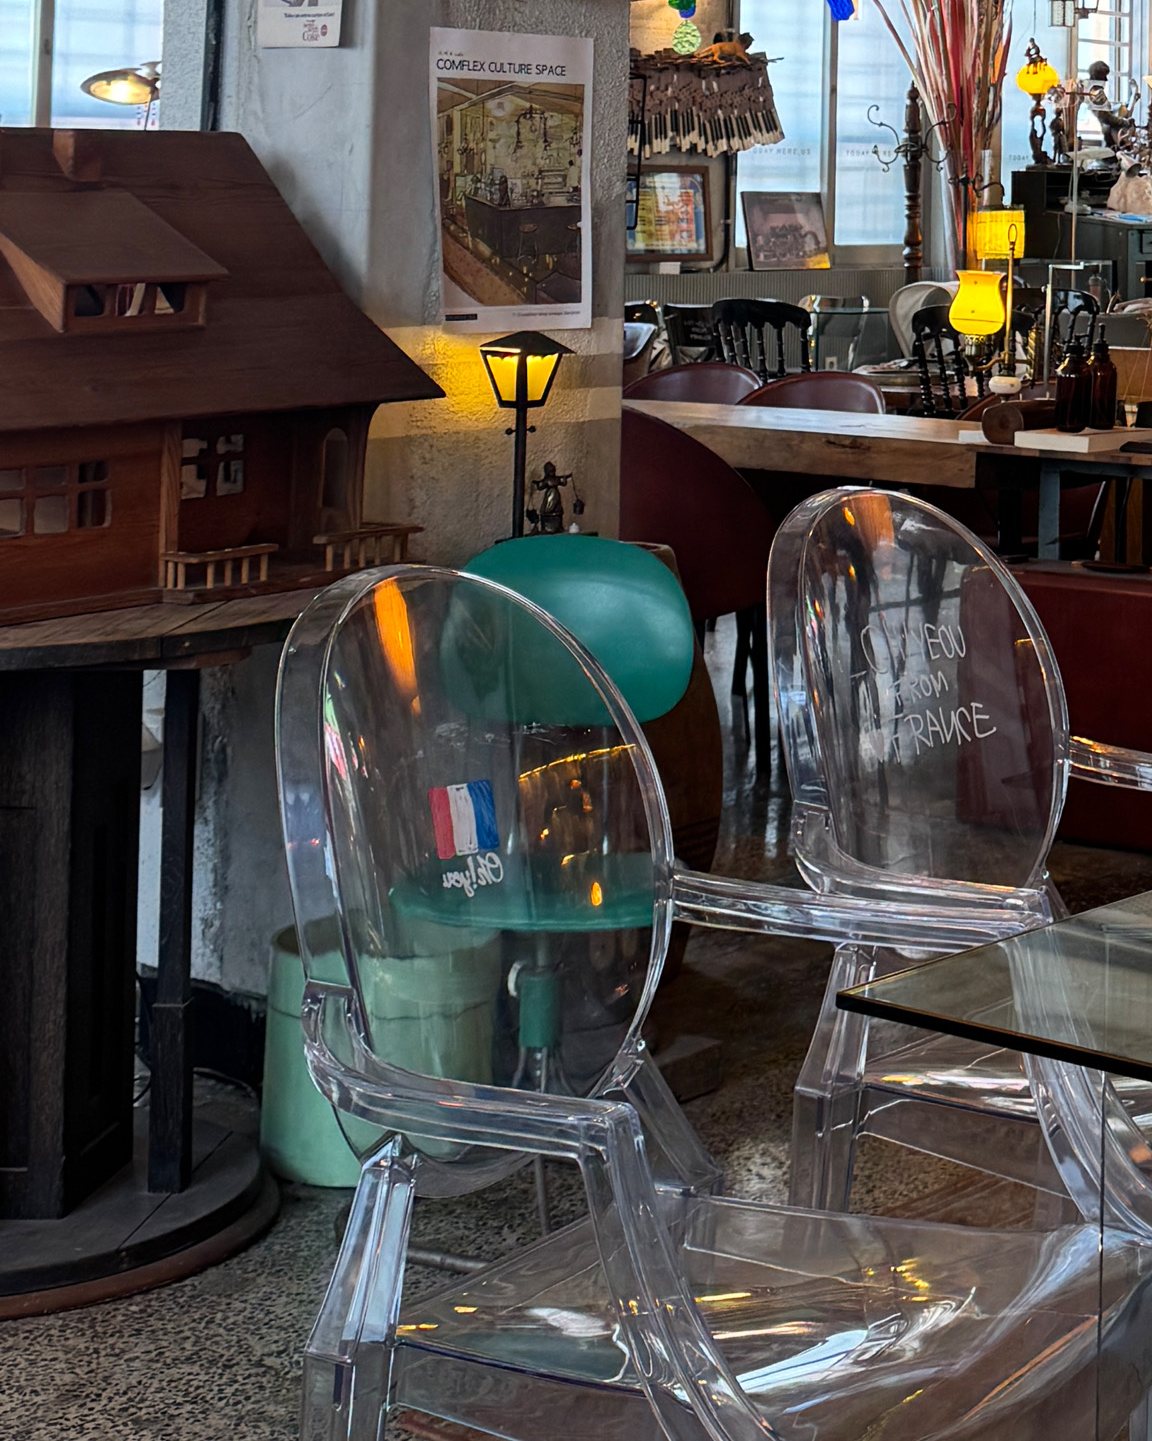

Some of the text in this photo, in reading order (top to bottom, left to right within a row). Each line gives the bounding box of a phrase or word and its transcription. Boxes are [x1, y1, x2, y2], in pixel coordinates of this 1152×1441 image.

[488, 61, 532, 74] CULTURE
[535, 64, 566, 76] SPACE
[886, 702, 997, 763] FRANCE
